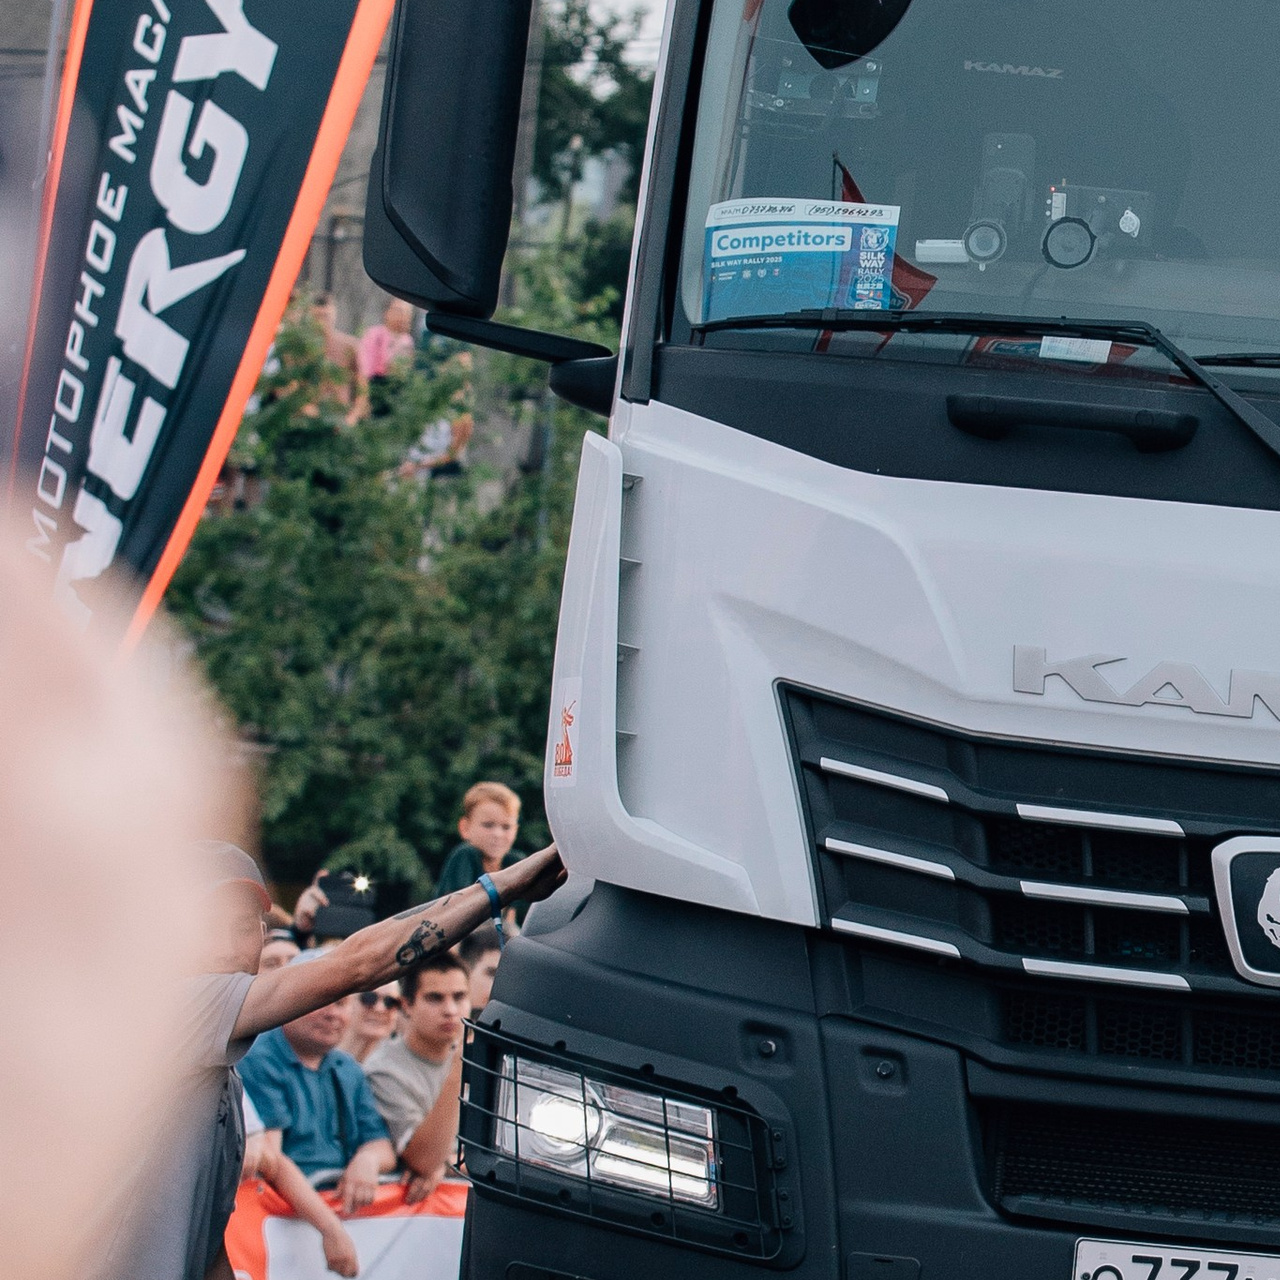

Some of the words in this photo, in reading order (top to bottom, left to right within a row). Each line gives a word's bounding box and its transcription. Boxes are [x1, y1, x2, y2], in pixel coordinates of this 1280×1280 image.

[964, 60, 1063, 79] KAMAZ
[717, 230, 846, 251] Competitors
[860, 251, 885, 260] SILK
[711, 261, 726, 269] SILK
[727, 259, 742, 267] WAY
[743, 257, 764, 265] RALLY
[765, 256, 783, 264] 2025
[860, 260, 885, 268] WAY
[858, 275, 885, 283] 2025
